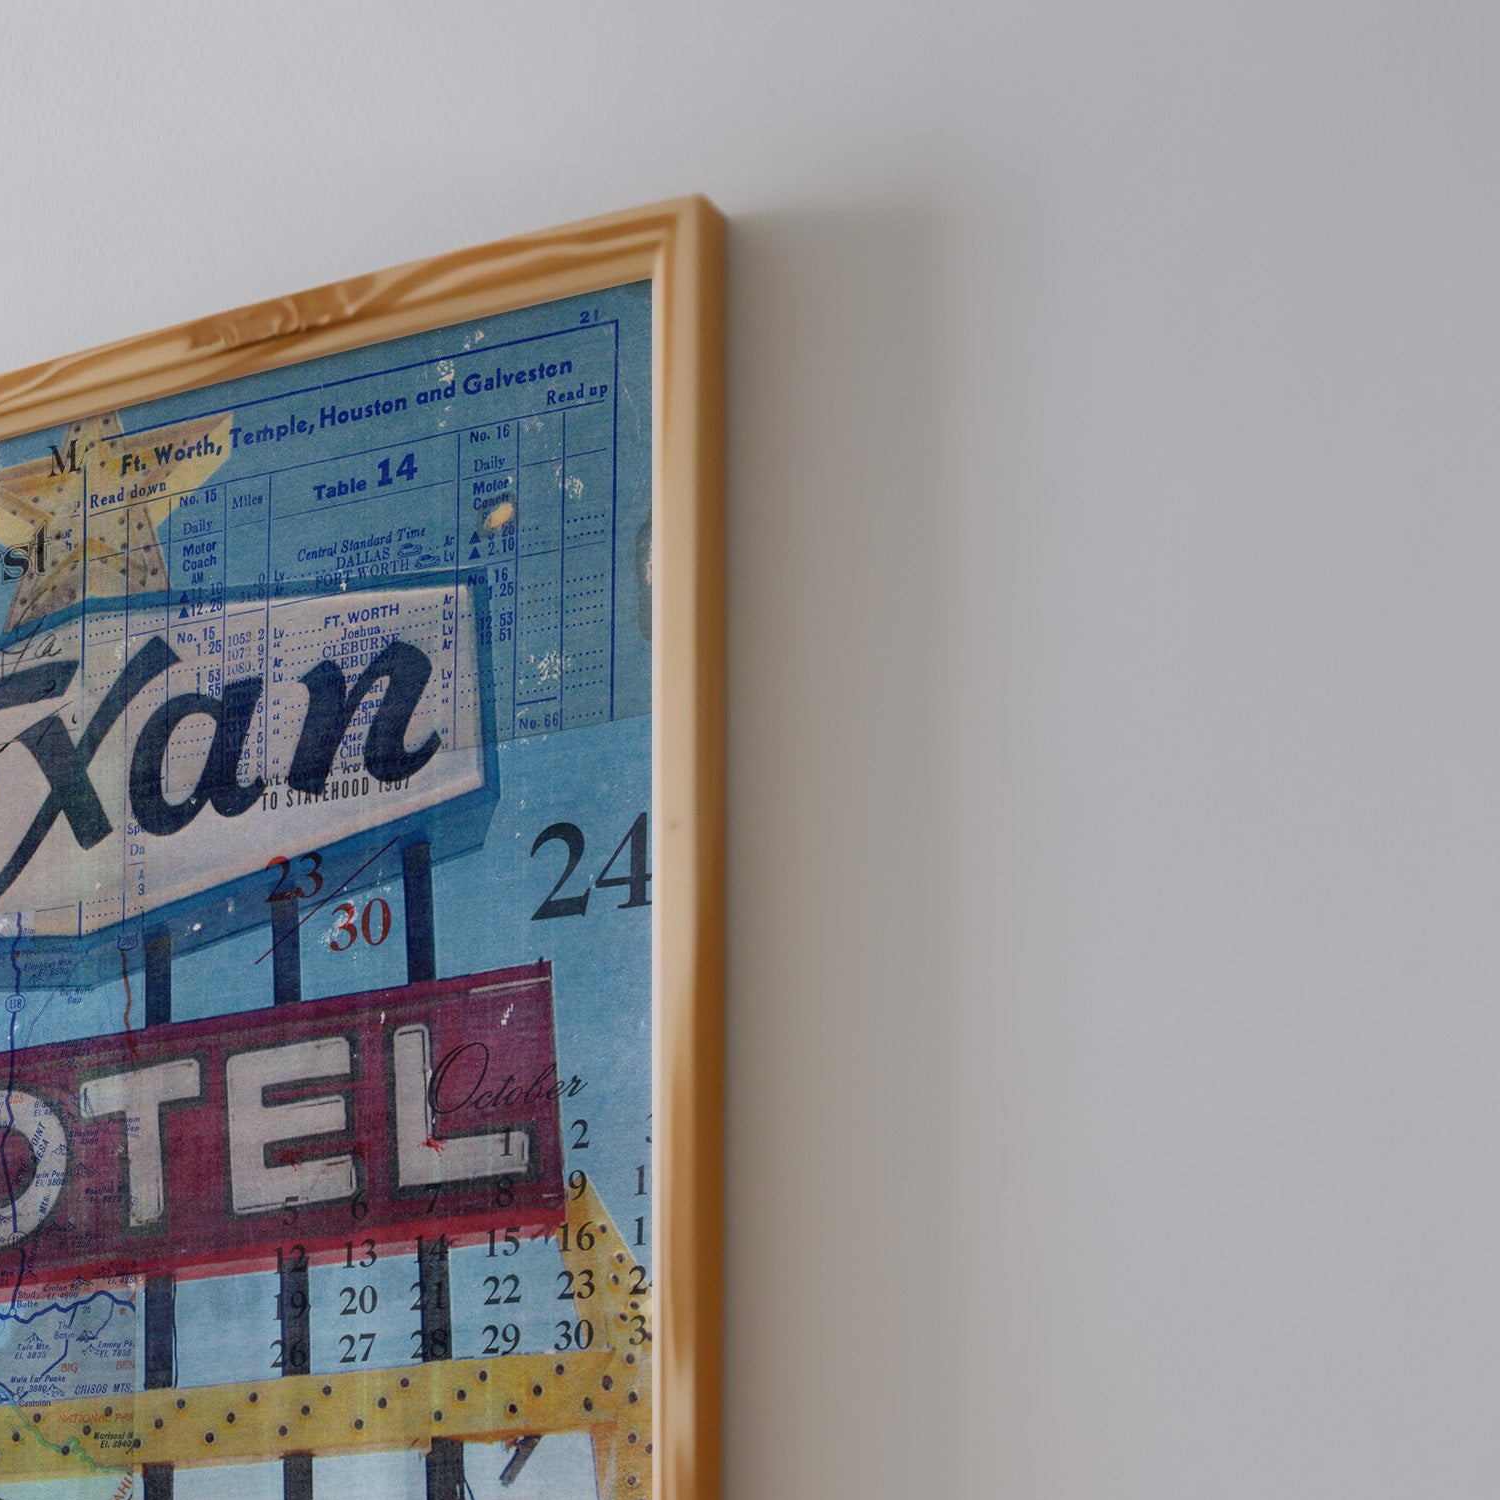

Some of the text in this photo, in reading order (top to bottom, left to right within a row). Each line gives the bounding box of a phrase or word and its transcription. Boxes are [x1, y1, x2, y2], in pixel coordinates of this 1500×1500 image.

[580, 309, 599, 324] 21
[546, 382, 609, 407] Read up
[121, 358, 573, 475] Ft. Worth, Temple, Houston and Galveston
[469, 424, 510, 445] No. 16
[473, 455, 506, 474] Daily
[313, 453, 419, 501] Table 14
[472, 478, 511, 496] Motor
[89, 481, 167, 509] Read down
[179, 488, 218, 507] No. 15
[231, 493, 264, 511] Miles
[183, 519, 214, 537] Daily
[183, 539, 217, 558] Motor
[297, 526, 427, 562] Central Standard Time
[183, 554, 217, 573] Coach
[336, 548, 391, 570] DALLAS
[191, 573, 205, 585] AM
[315, 557, 410, 590] FORT WORTH
[467, 567, 509, 587] No. 16
[324, 603, 400, 630] FT. WORTH
[176, 626, 216, 645] No. 15
[341, 625, 382, 641] Joshua
[322, 632, 400, 660] CLEBURNE
[518, 711, 559, 731] No. 66
[262, 791, 279, 811] TO
[286, 776, 370, 808] STATEHOOD
[530, 811, 653, 922] 24
[264, 851, 324, 903] 23
[329, 897, 392, 952] 30
[427, 1042, 587, 1114] October
[499, 1118, 590, 1157] 1 2
[567, 1169, 587, 1201] 9
[274, 1221, 596, 1275] 12 13 14 15 16
[16, 1300, 39, 1309] Butte
[17, 1290, 41, 1300] Study
[274, 1268, 596, 1321] 19 20 21 22 23
[58, 1321, 73, 1330] The
[269, 1318, 595, 1369] 26 27 28 29 30
[60, 1362, 79, 1373] BIG
[74, 1382, 133, 1395] CHISOS MTS.
[17, 1399, 52, 1408] Castolon
[57, 1413, 111, 1424] NATIONAL
